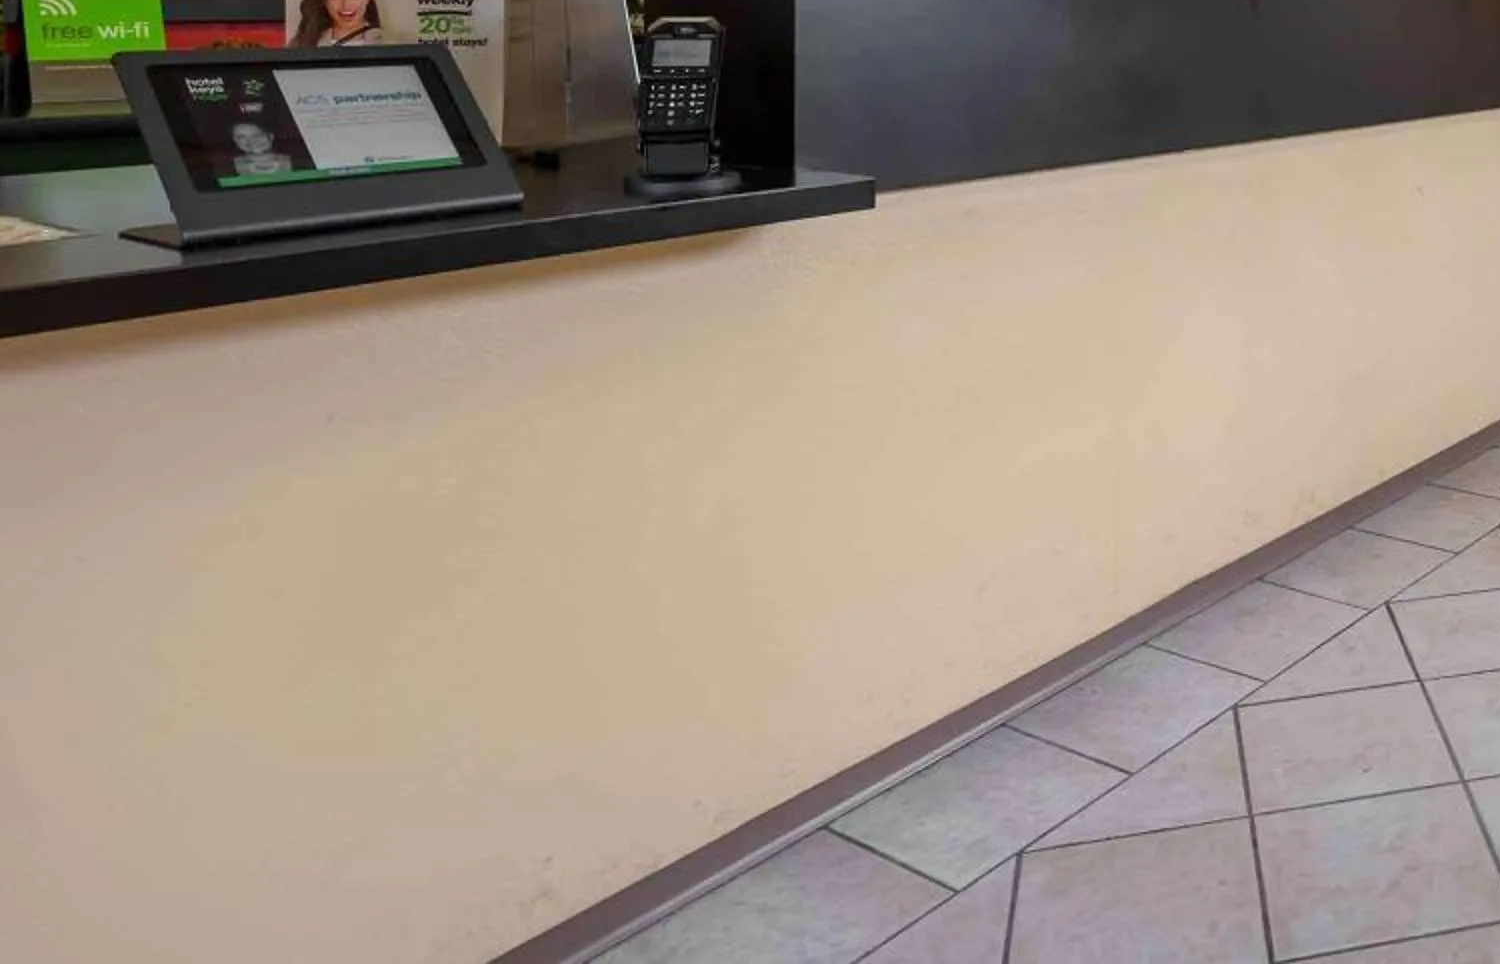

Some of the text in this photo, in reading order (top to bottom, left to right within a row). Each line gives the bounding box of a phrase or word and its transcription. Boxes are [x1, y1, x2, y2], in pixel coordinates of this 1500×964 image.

[42, 20, 150, 40] free wi-fi
[332, 91, 422, 105] partnership
